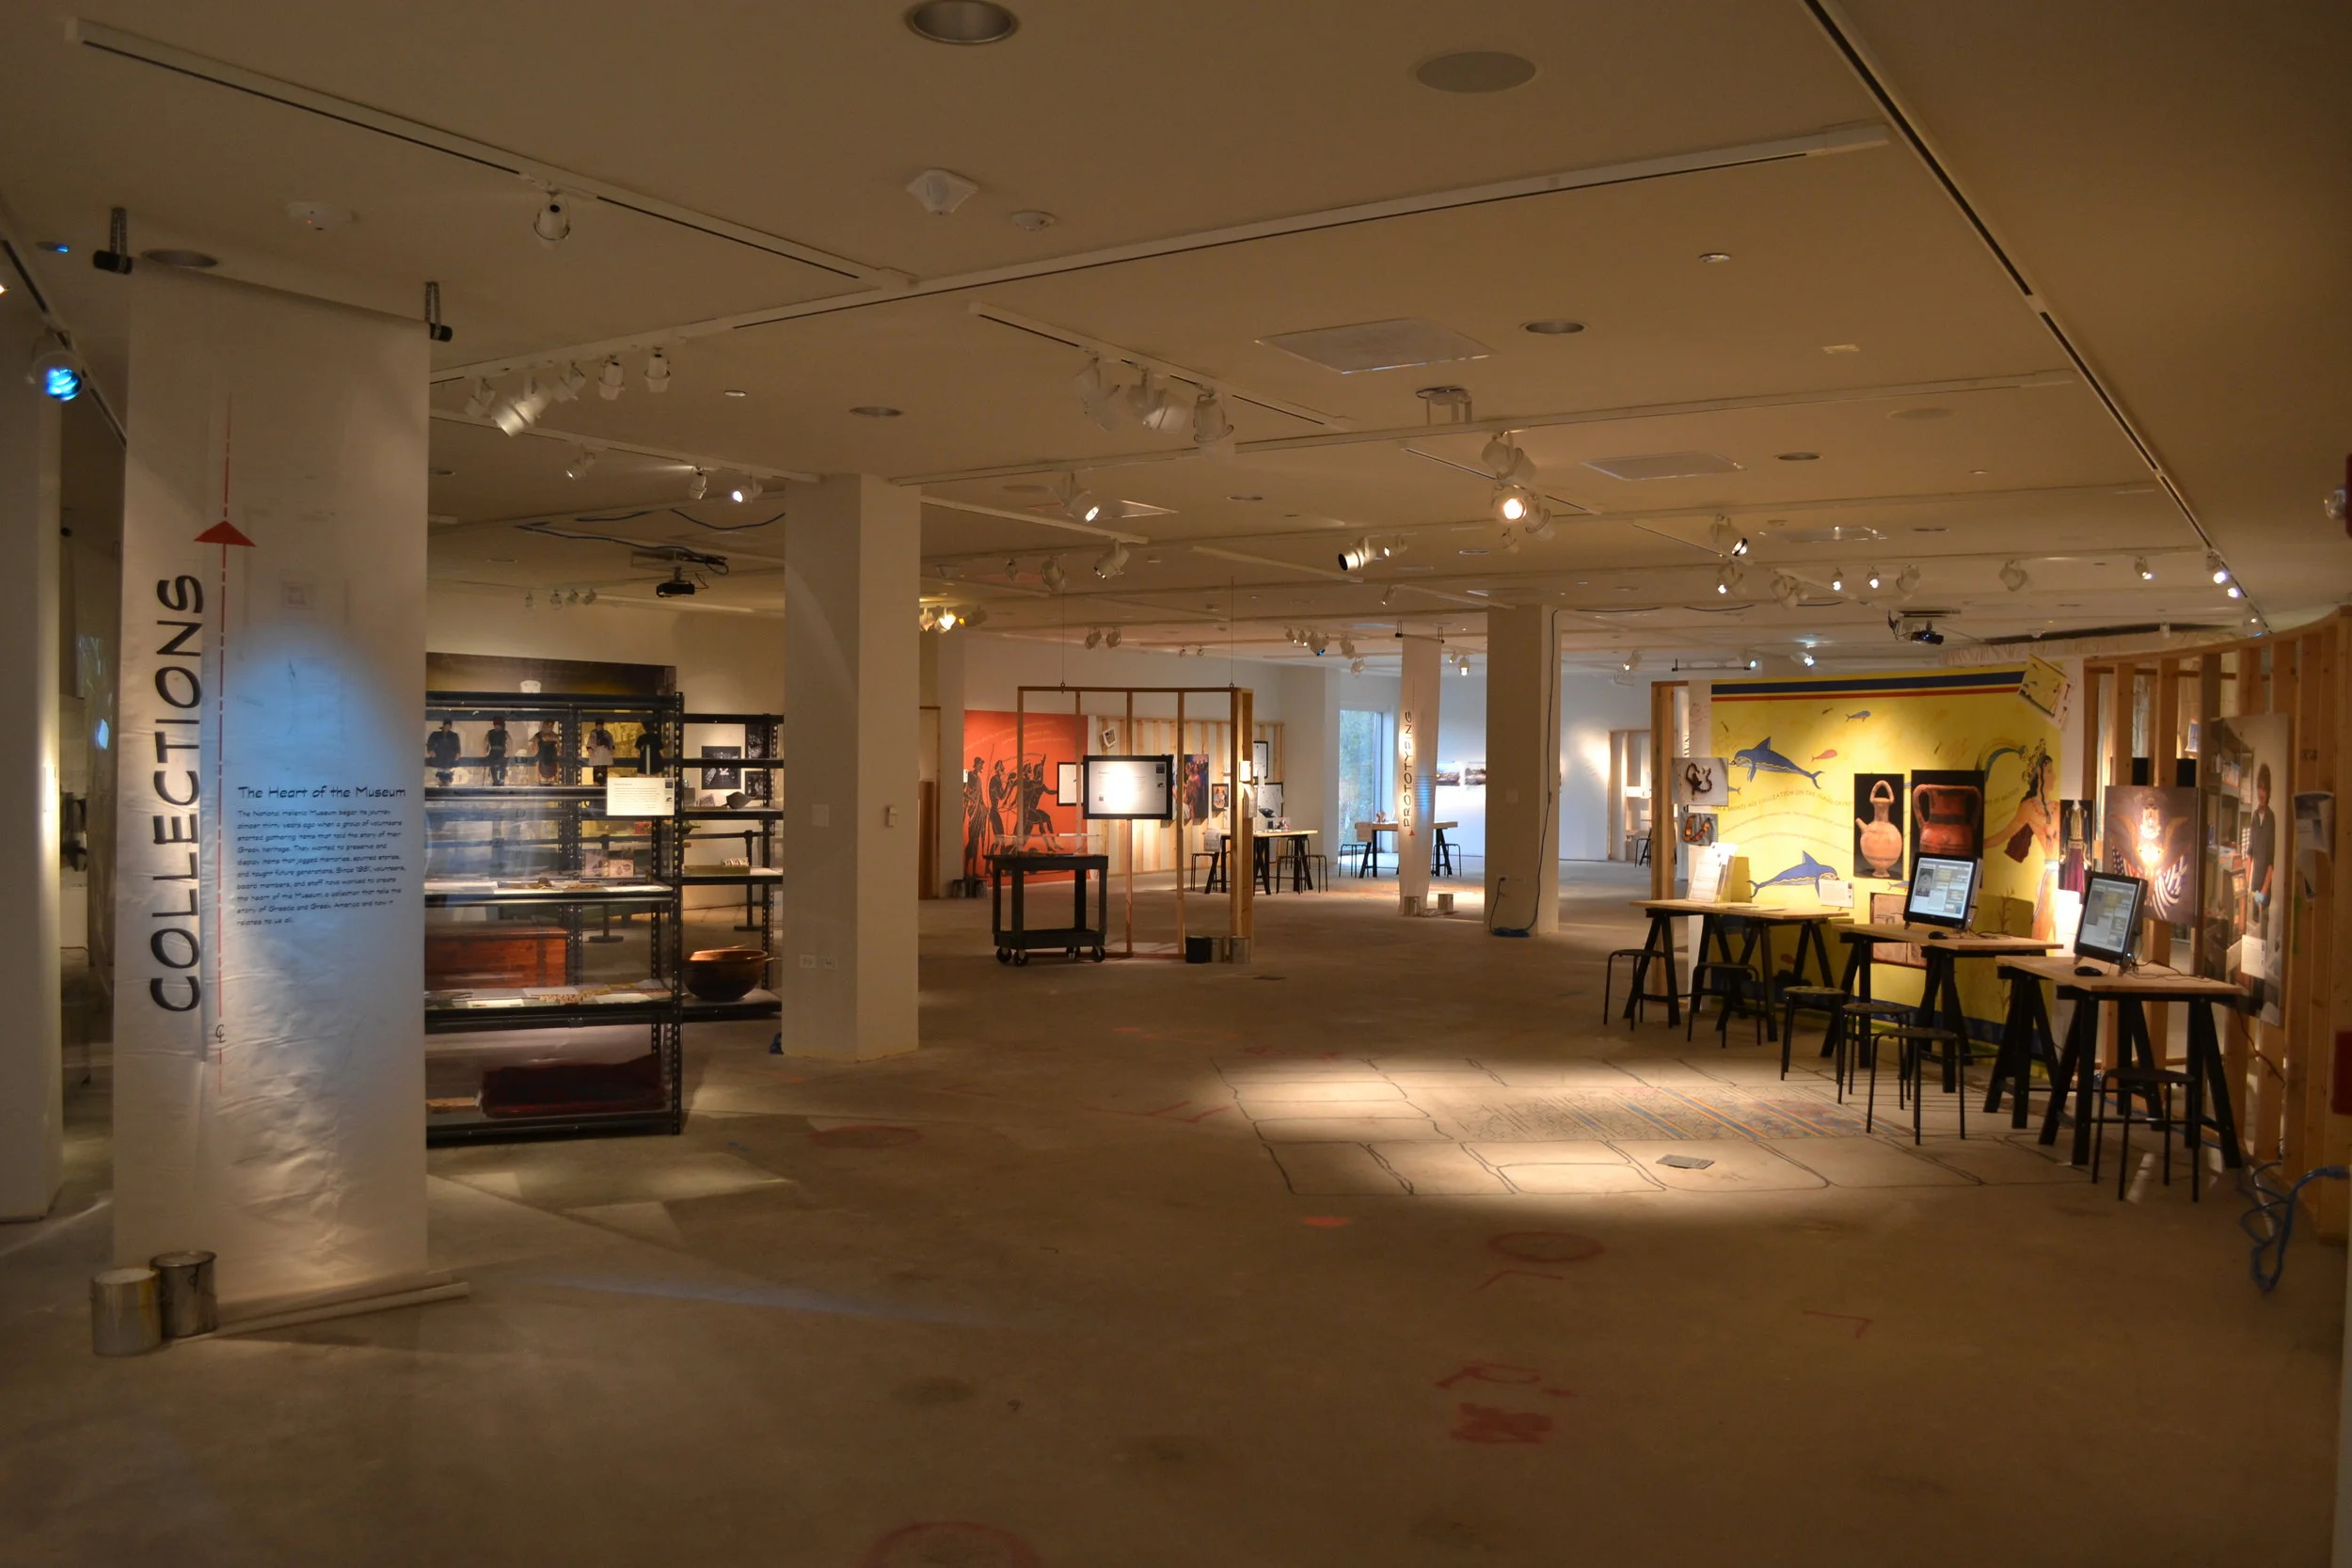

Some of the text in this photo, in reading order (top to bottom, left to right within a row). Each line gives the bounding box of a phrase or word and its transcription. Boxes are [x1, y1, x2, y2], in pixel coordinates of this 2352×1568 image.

[150, 575, 203, 1012] COLLECTIONS
[237, 784, 406, 799] The Heart of the Museum
[1404, 710, 1413, 828] PROTOTYPING
